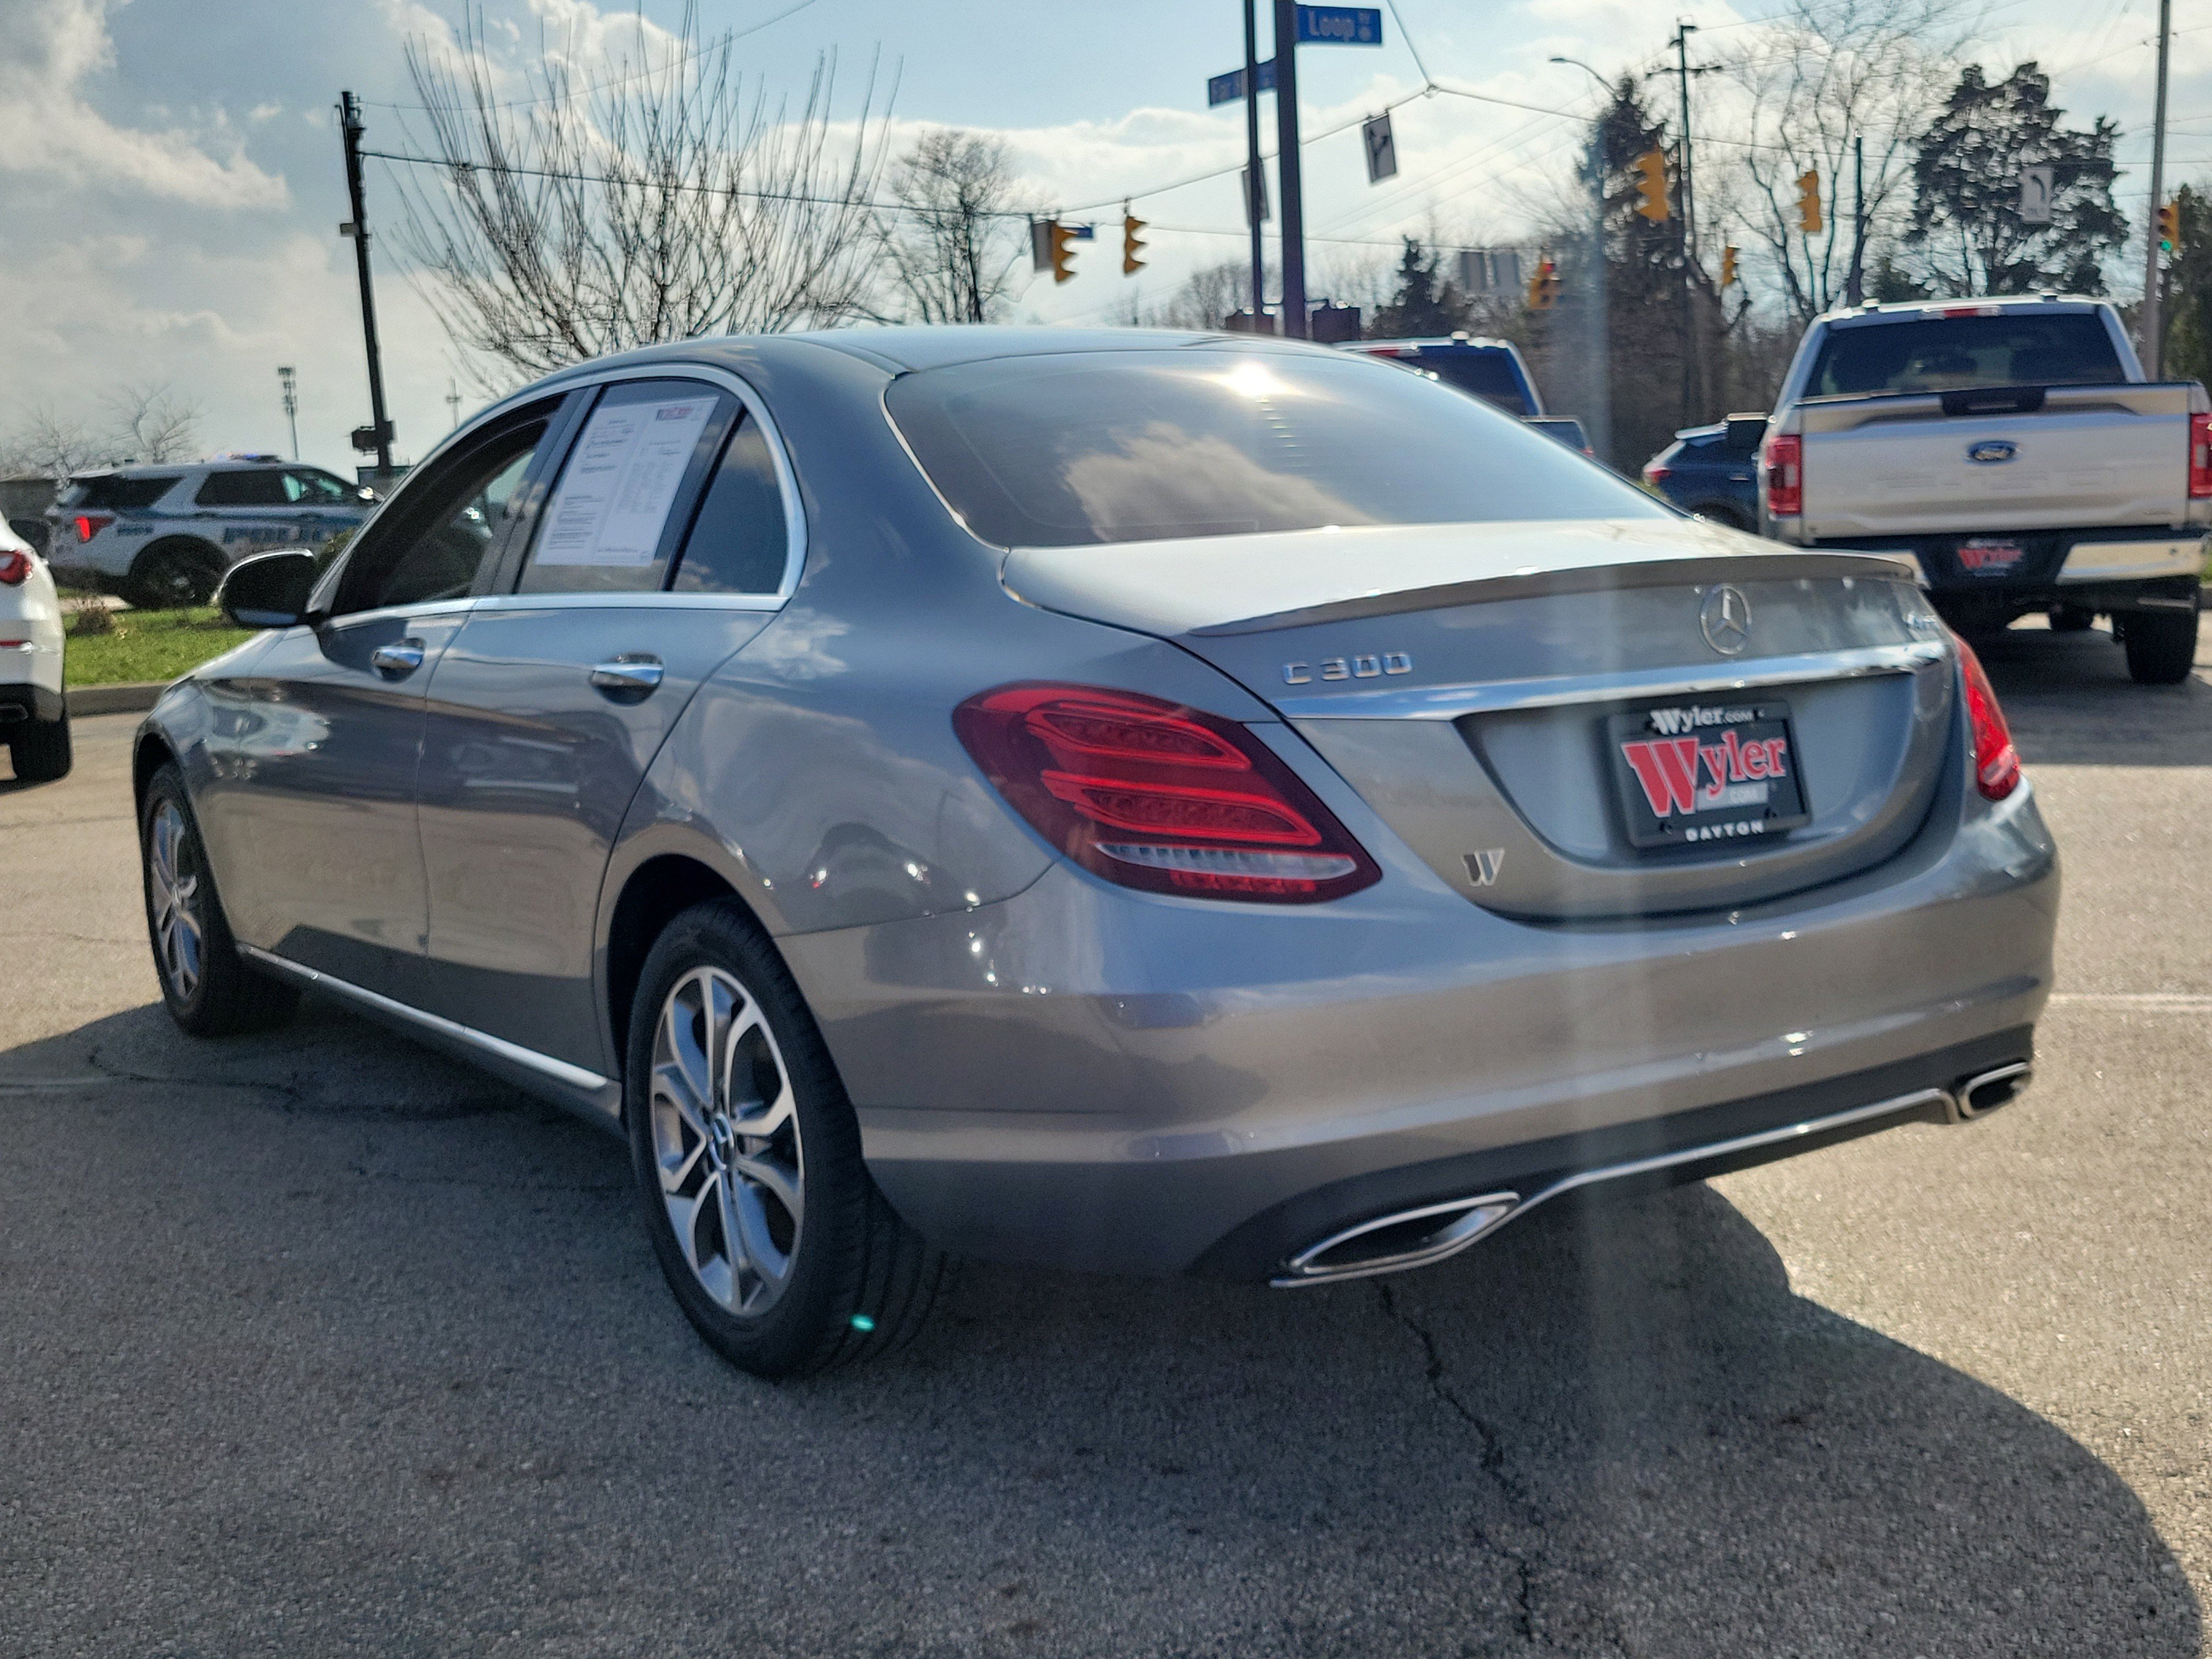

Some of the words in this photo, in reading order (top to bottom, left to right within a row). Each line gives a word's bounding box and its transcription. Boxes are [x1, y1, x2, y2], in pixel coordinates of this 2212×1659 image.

[1308, 10, 1356, 42] Loop
[1283, 662, 1312, 684] C
[1320, 652, 1413, 681] 300
[1621, 730, 1786, 817] Wyler
[1685, 821, 1764, 842] DAYTON
